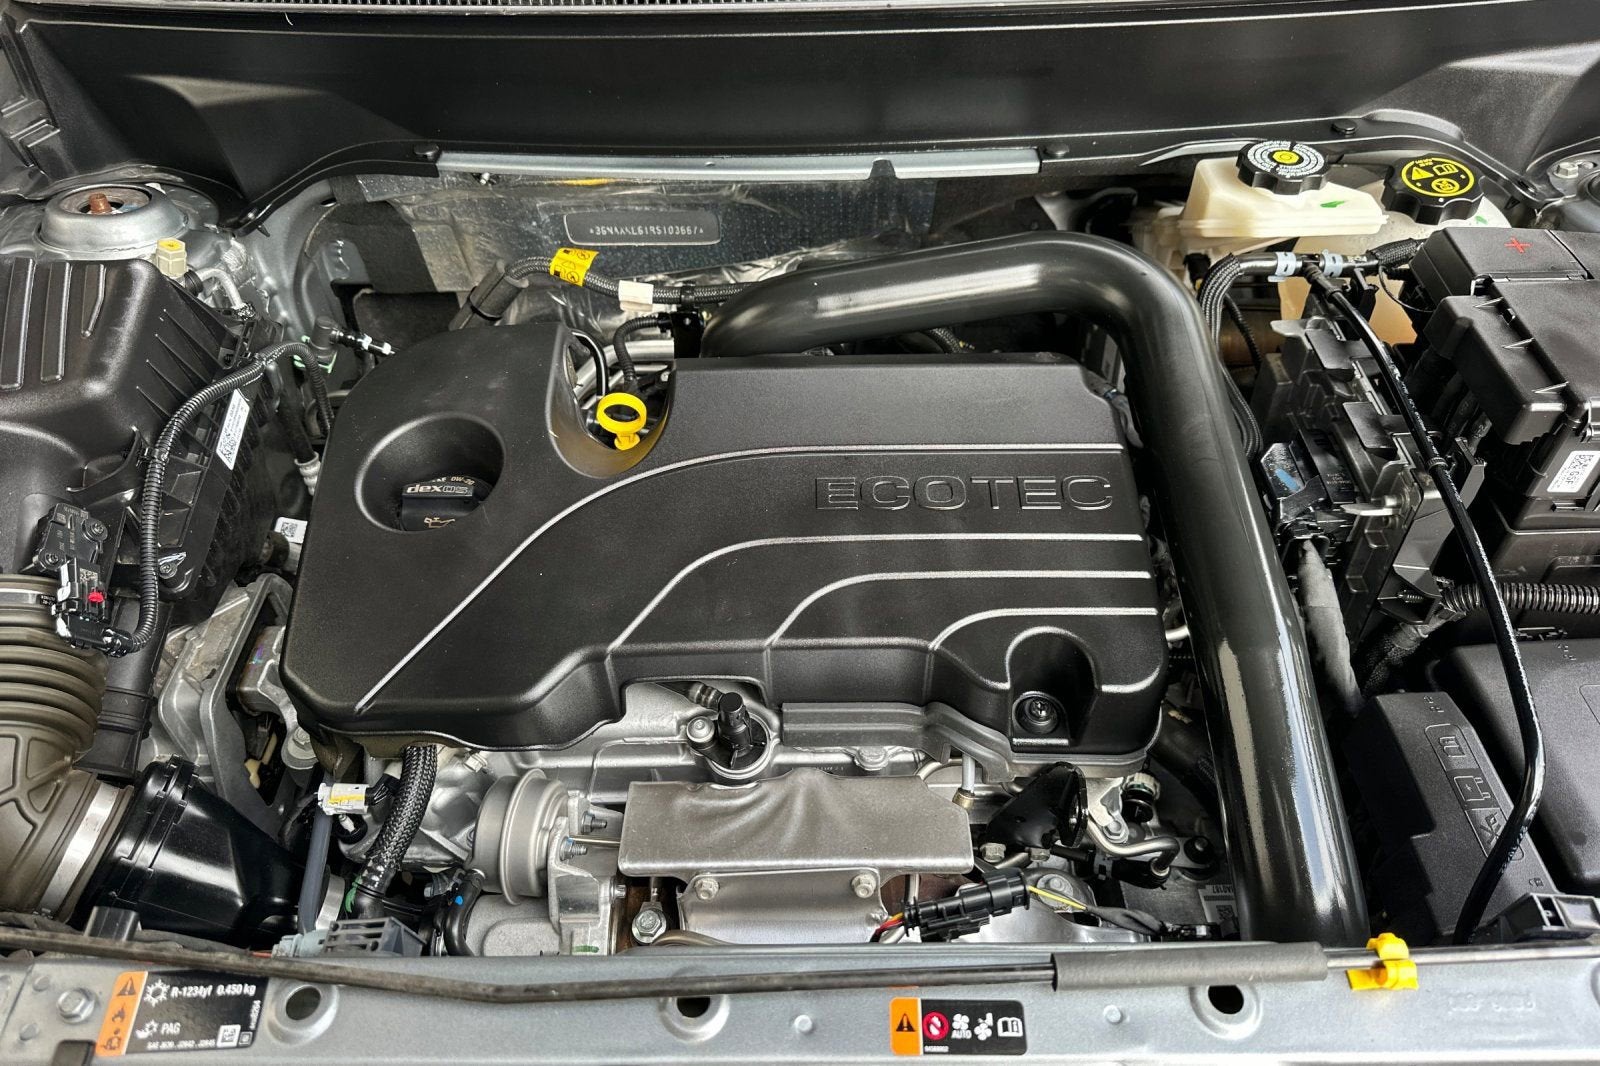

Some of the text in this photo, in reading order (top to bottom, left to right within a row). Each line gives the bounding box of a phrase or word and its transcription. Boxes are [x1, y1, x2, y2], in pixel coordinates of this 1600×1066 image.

[815, 475, 1113, 510] ECOTEC
[171, 985, 213, 998] R-1234yf
[243, 983, 256, 997] kg
[160, 1022, 181, 1035] PAG
[951, 1029, 972, 1039] AUTO
